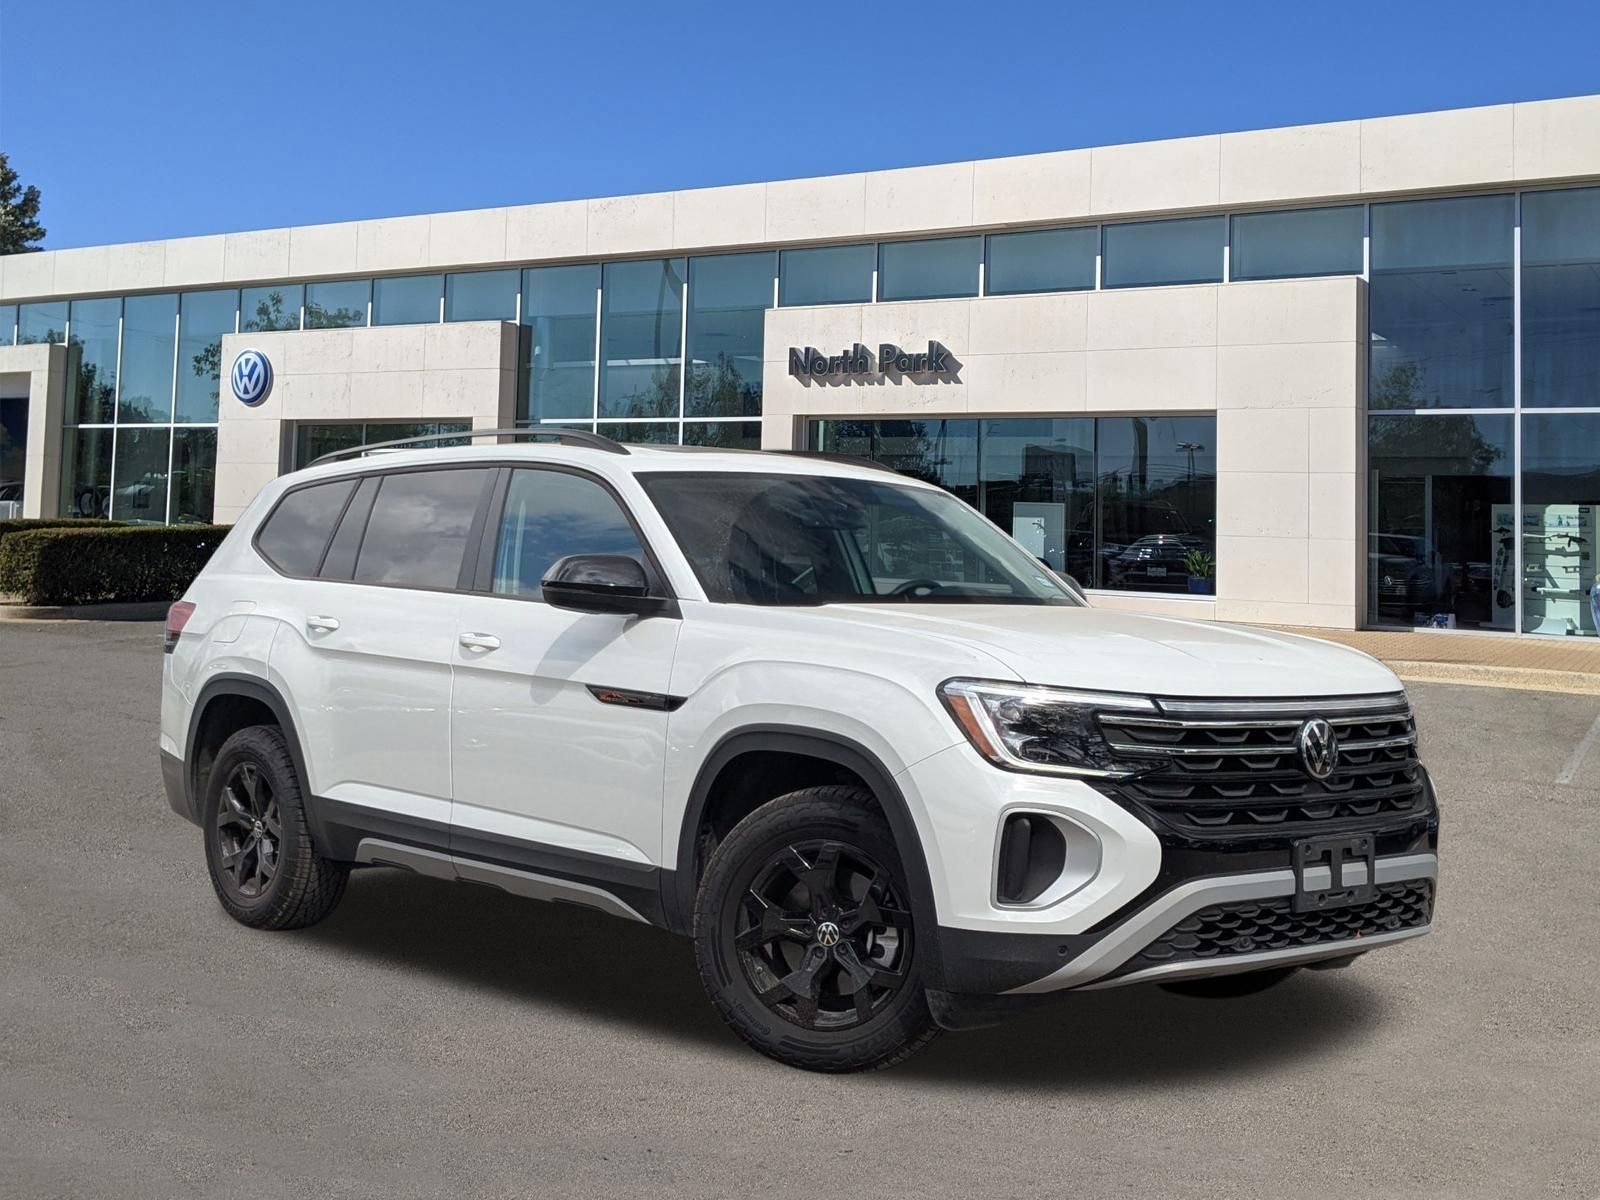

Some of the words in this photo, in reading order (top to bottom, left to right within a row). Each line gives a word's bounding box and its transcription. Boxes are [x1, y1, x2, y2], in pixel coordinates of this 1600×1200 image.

[232, 351, 266, 401] VW
[788, 343, 873, 376] North
[878, 339, 950, 374] Park
